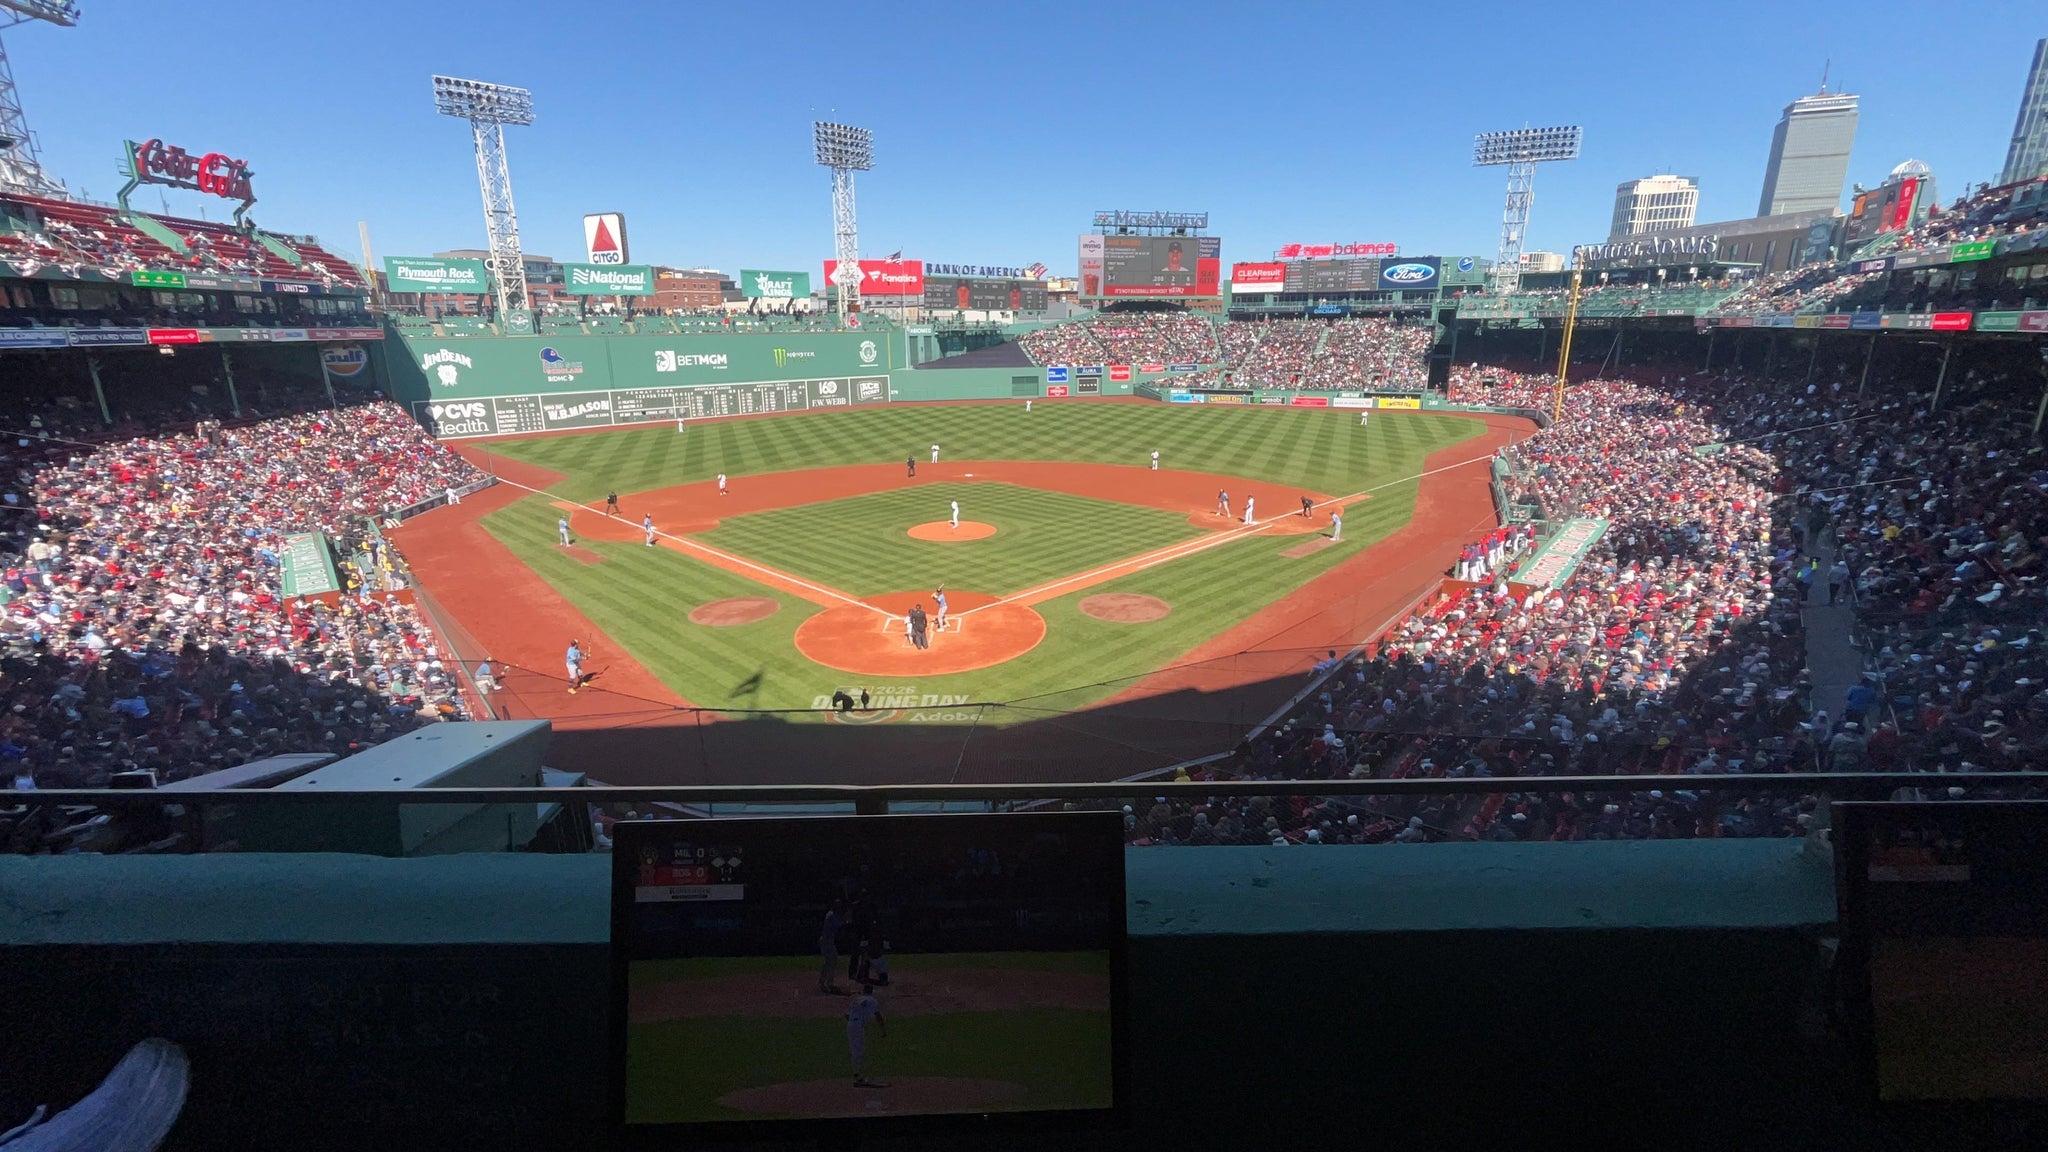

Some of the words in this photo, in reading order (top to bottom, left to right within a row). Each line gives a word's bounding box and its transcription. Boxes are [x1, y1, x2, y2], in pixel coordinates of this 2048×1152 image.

[1115, 210, 1208, 228] MassMutual
[1303, 245, 1332, 257] new
[1333, 242, 1395, 256] balance
[1571, 240, 1643, 265] SAMUEL
[1646, 234, 1718, 257] ADAMS
[592, 252, 619, 264] CITGO
[397, 267, 446, 278] Plymouth
[449, 267, 474, 279] Rock
[926, 263, 958, 274] BANK
[963, 264, 976, 275] OF
[979, 266, 1026, 277] AMERICA
[1238, 269, 1280, 277] CLEAResult
[1394, 267, 1424, 280] Ford
[882, 273, 918, 283] Fanatics
[282, 284, 308, 293] UNITED
[758, 279, 793, 290] DRAFT
[762, 287, 793, 297] KINGS
[324, 349, 364, 363] Gulf
[422, 352, 441, 371] JIM
[440, 349, 472, 369] BEAM
[677, 354, 728, 366] BETMGM
[861, 383, 880, 391] ACE
[826, 398, 846, 406] WEBB
[445, 402, 487, 419] CVS
[430, 418, 490, 437] Health
[876, 686, 916, 695] 2026
[921, 694, 969, 707] DAY
[909, 711, 984, 721] Adobe
[674, 849, 691, 857] MIL
[697, 848, 704, 858] 0
[696, 867, 704, 877] 0
